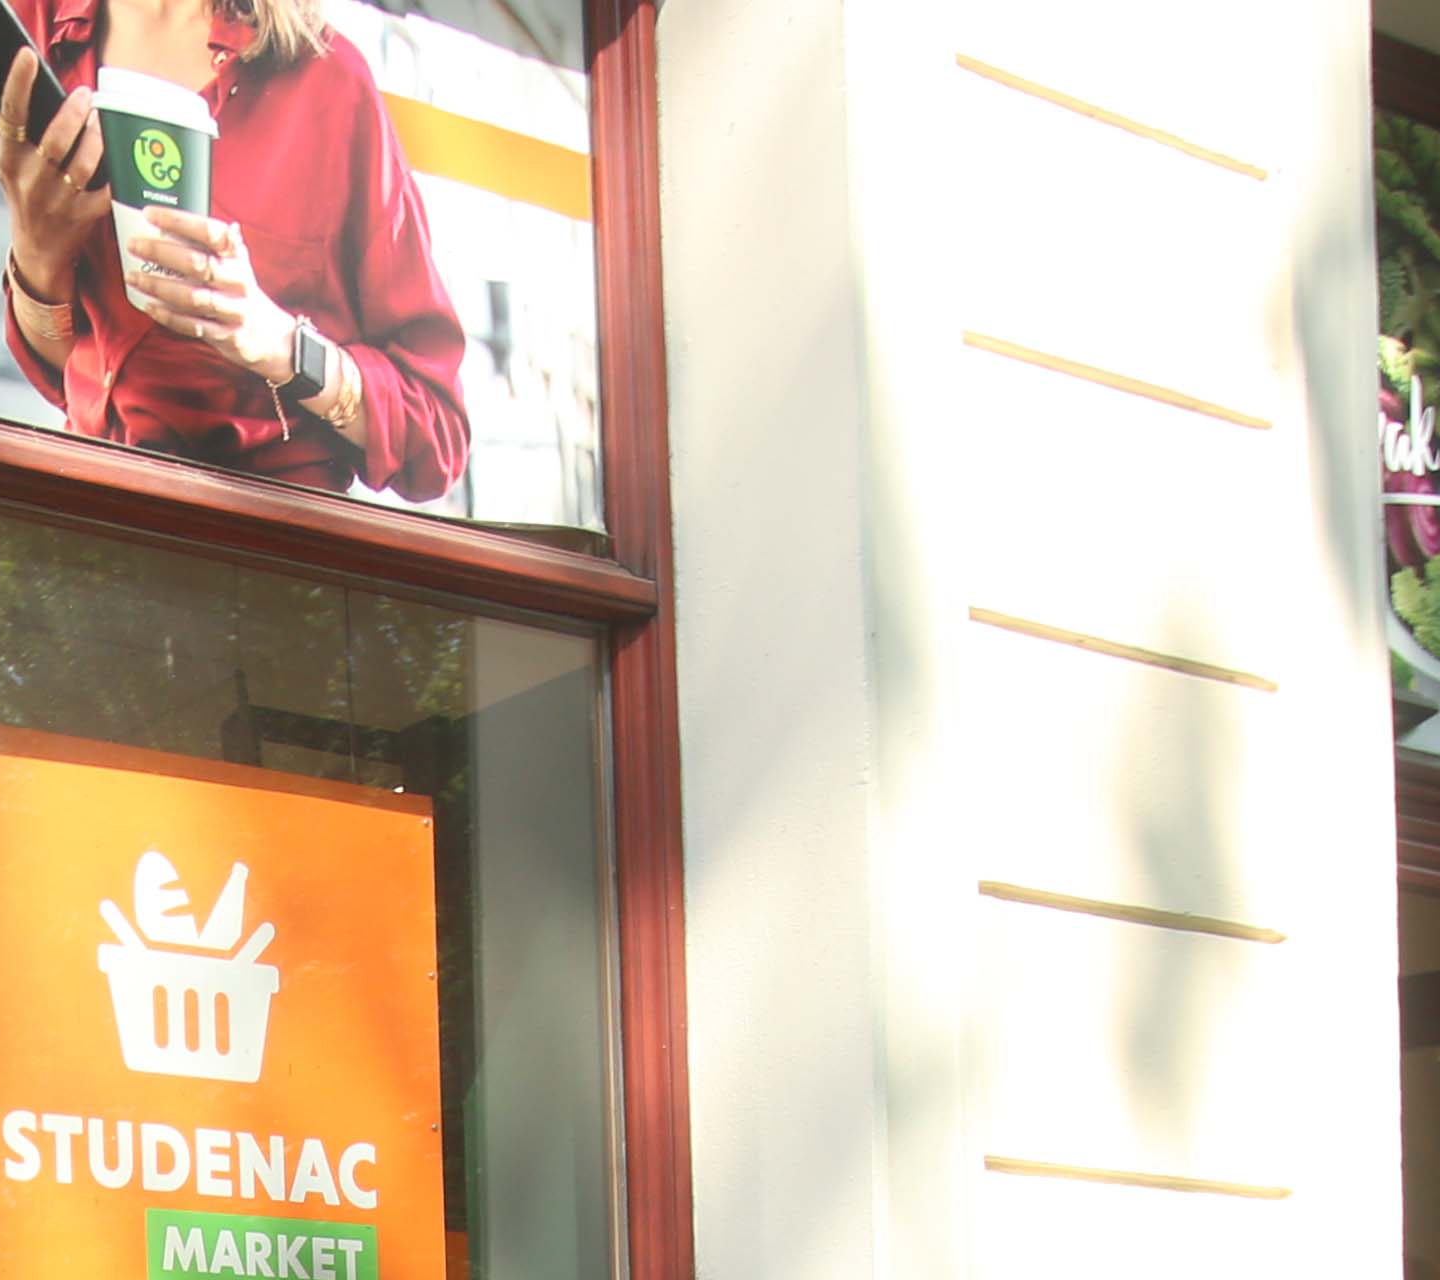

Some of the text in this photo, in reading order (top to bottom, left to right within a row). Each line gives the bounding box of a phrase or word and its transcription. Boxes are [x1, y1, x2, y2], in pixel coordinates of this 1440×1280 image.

[138, 137, 165, 158] TO
[151, 161, 181, 184] GO
[1, 1109, 378, 1209] STUDENAC
